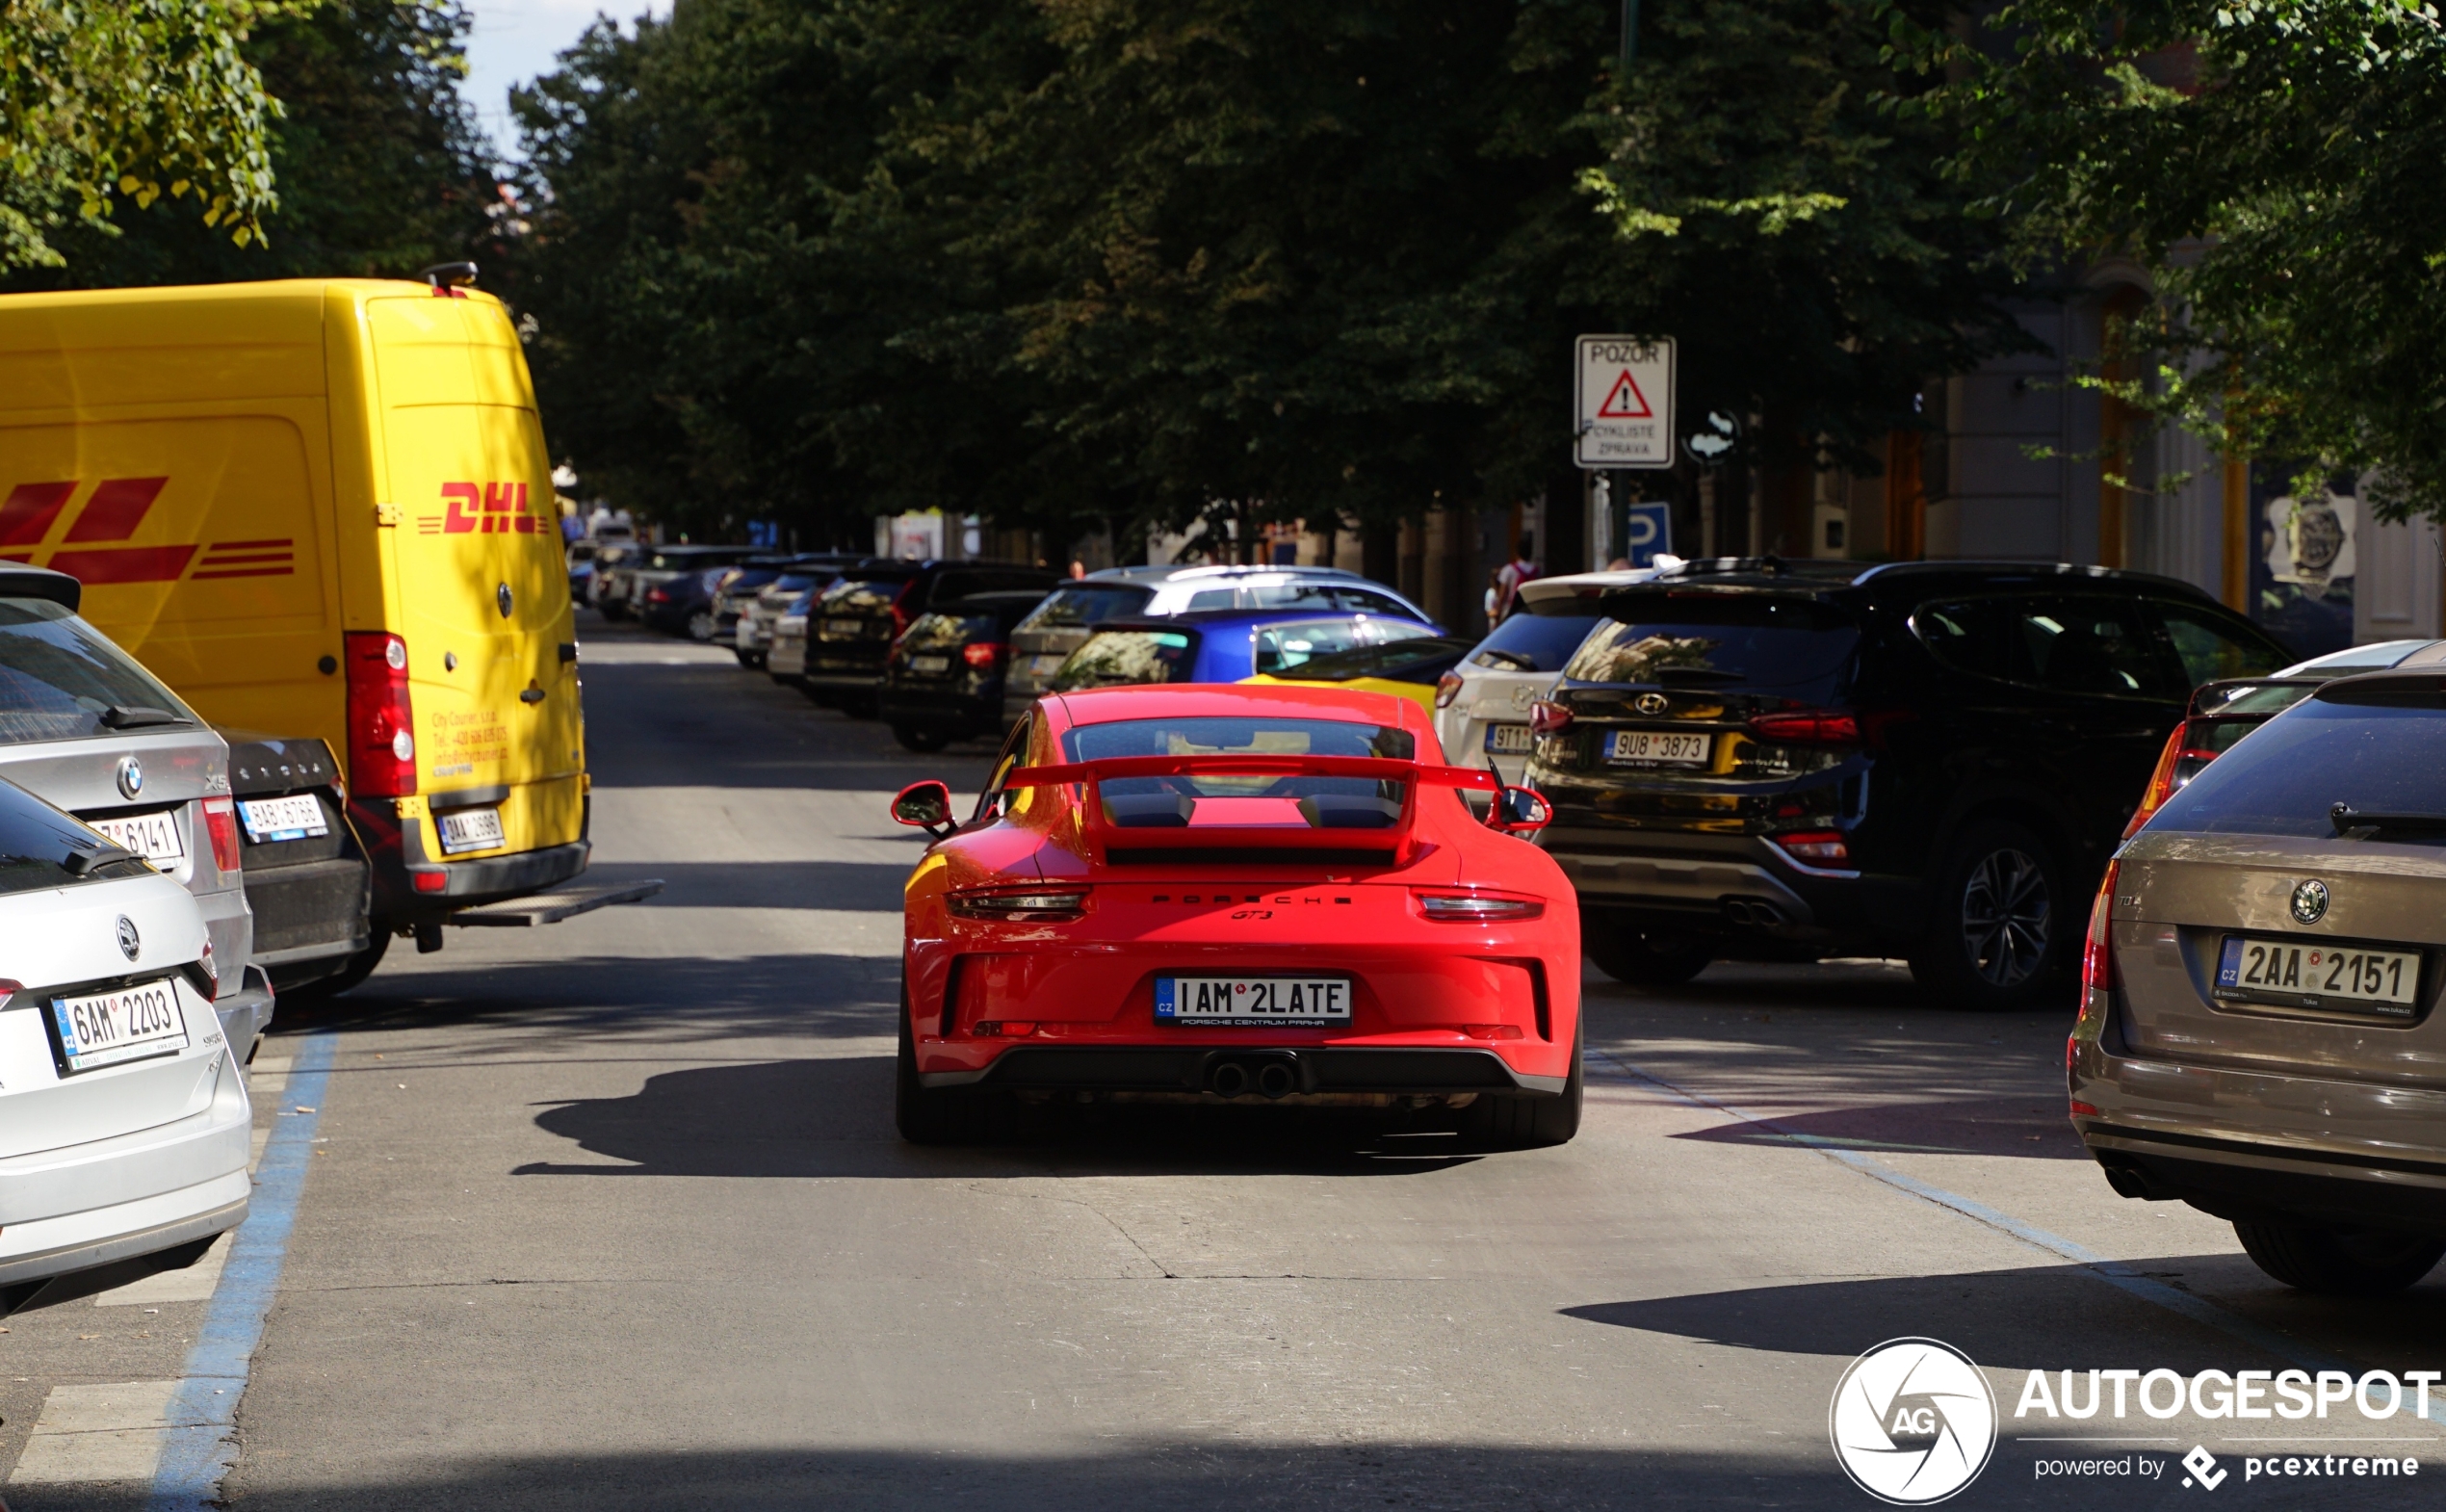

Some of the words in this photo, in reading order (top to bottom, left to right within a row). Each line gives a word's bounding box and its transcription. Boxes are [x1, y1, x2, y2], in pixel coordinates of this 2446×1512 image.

[1591, 344, 1658, 363] POZOR
[1599, 443, 1651, 455] ZPRAVA
[441, 482, 535, 534] DHL
[1618, 735, 1649, 755] 9U8
[1660, 737, 1702, 758] 3873
[204, 774, 227, 791] X5
[126, 820, 170, 853] 6141
[1152, 895, 1351, 904] PORSCHE
[1231, 910, 1273, 920] GT3
[2222, 969, 2236, 981] CZ
[2245, 947, 2301, 988] 2AA
[2324, 952, 2403, 997] 2151
[1158, 1004, 1173, 1012] CZ
[1251, 983, 1343, 1013] 2LATE
[2377, 1005, 2410, 1014] www.tukas.cz
[65, 1037, 76, 1048] CZ
[74, 1000, 116, 1046] 6AM
[122, 990, 171, 1036] 2203
[81, 1056, 101, 1068] ARVAL
[156, 1039, 185, 1052] www.arval.cz
